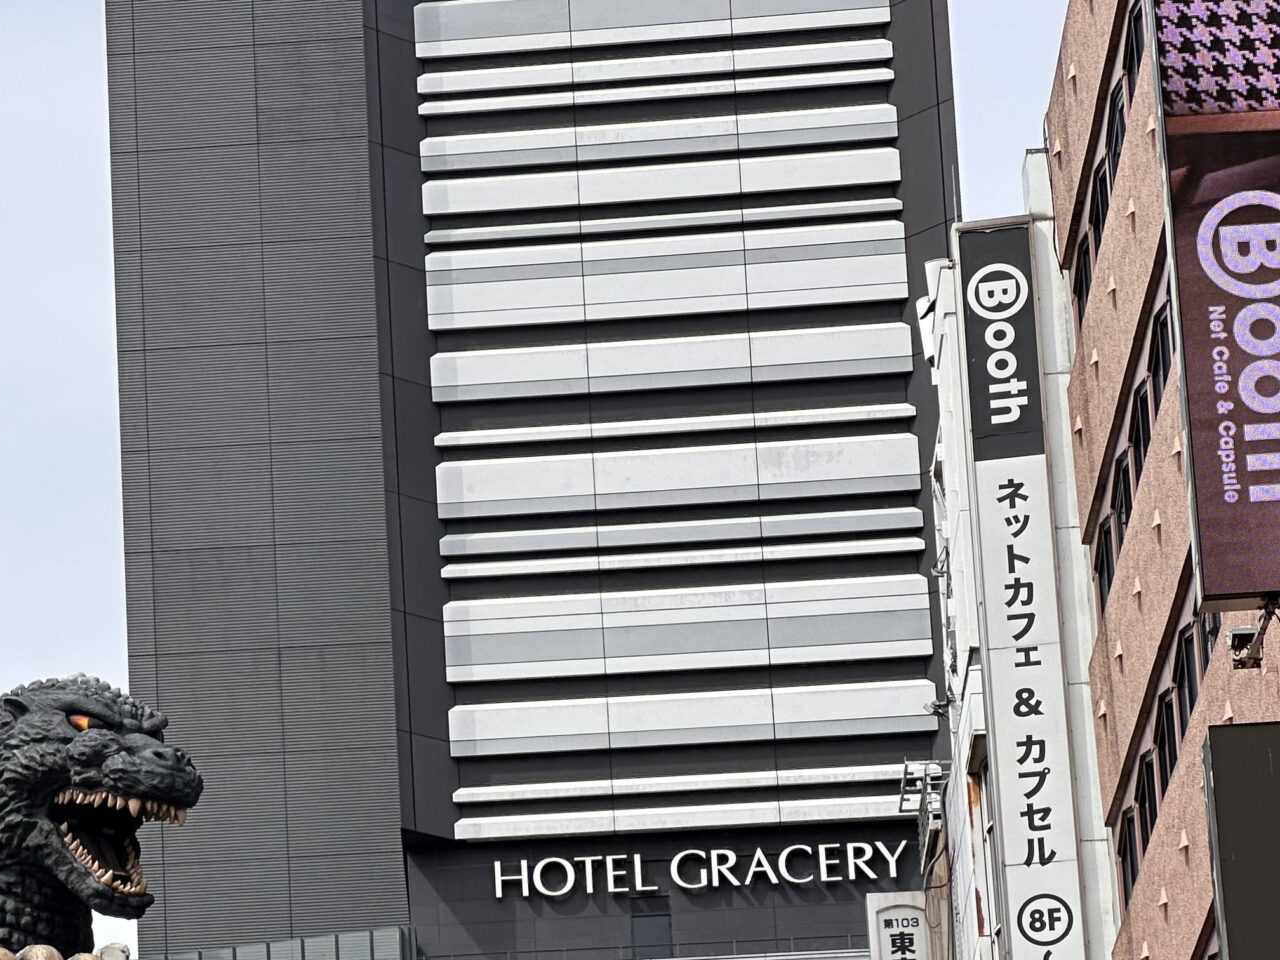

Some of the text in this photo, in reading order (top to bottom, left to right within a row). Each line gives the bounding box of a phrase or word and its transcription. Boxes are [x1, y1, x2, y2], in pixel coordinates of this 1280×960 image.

[967, 263, 1029, 424] Booth
[1208, 305, 1227, 339] Net
[1218, 421, 1241, 503] Capsule
[494, 840, 908, 898] HOTEL GRACERY
[884, 917, 919, 929] 第103
[1029, 906, 1062, 932] 8F
